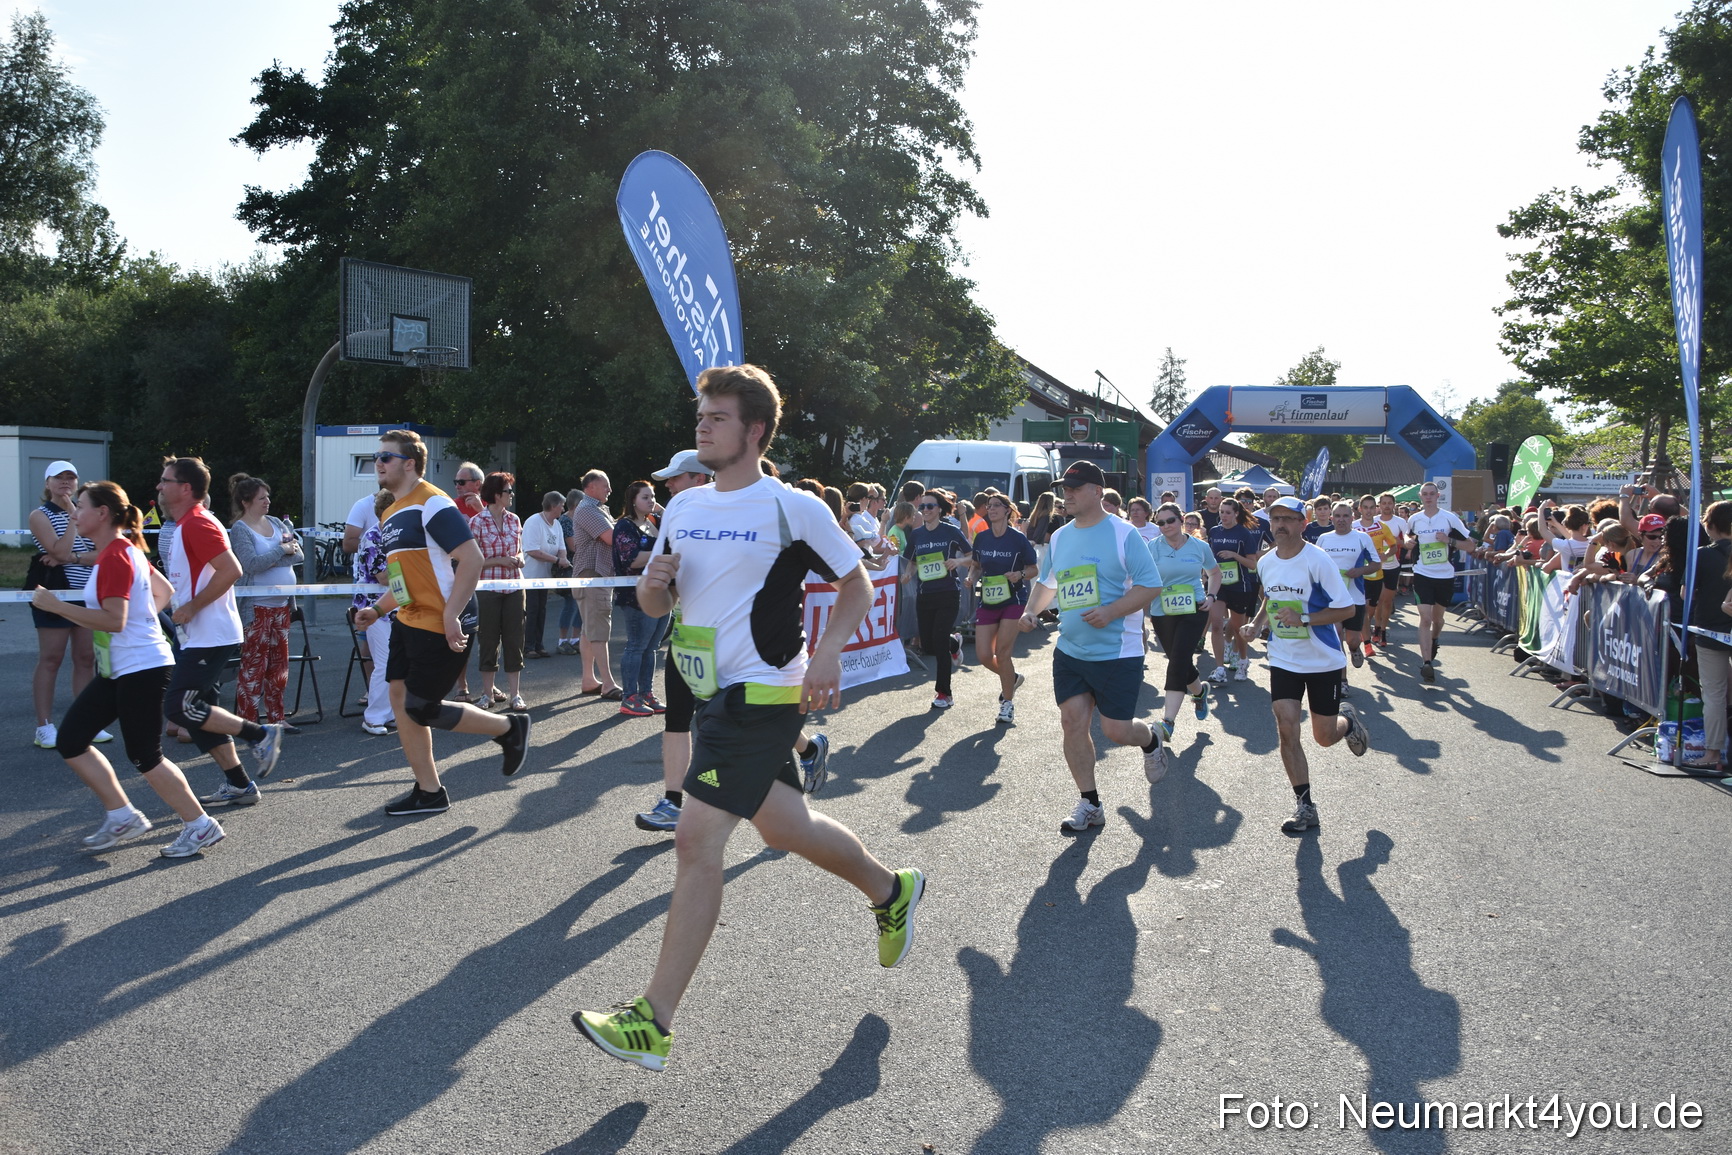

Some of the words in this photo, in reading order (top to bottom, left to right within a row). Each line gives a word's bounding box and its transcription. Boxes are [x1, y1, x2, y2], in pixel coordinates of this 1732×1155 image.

[1291, 409, 1350, 420] firmenlauf
[1182, 428, 1213, 436] Fischer
[1560, 472, 1583, 480] Jura
[1510, 475, 1531, 498] AOK
[676, 529, 757, 541] DELPHI
[917, 541, 929, 549] EURO
[1426, 550, 1442, 559] 265
[923, 563, 941, 574] 370
[1221, 571, 1234, 579] 76
[985, 586, 1004, 597] 372
[1061, 580, 1094, 599] 1424
[1266, 585, 1304, 595] DELPHI
[1164, 595, 1192, 607] 1426
[1604, 628, 1642, 668] Fischer
[677, 652, 704, 679] 270
[1606, 663, 1638, 687] AUTOMOBILE
[697, 774, 720, 788] adidas
